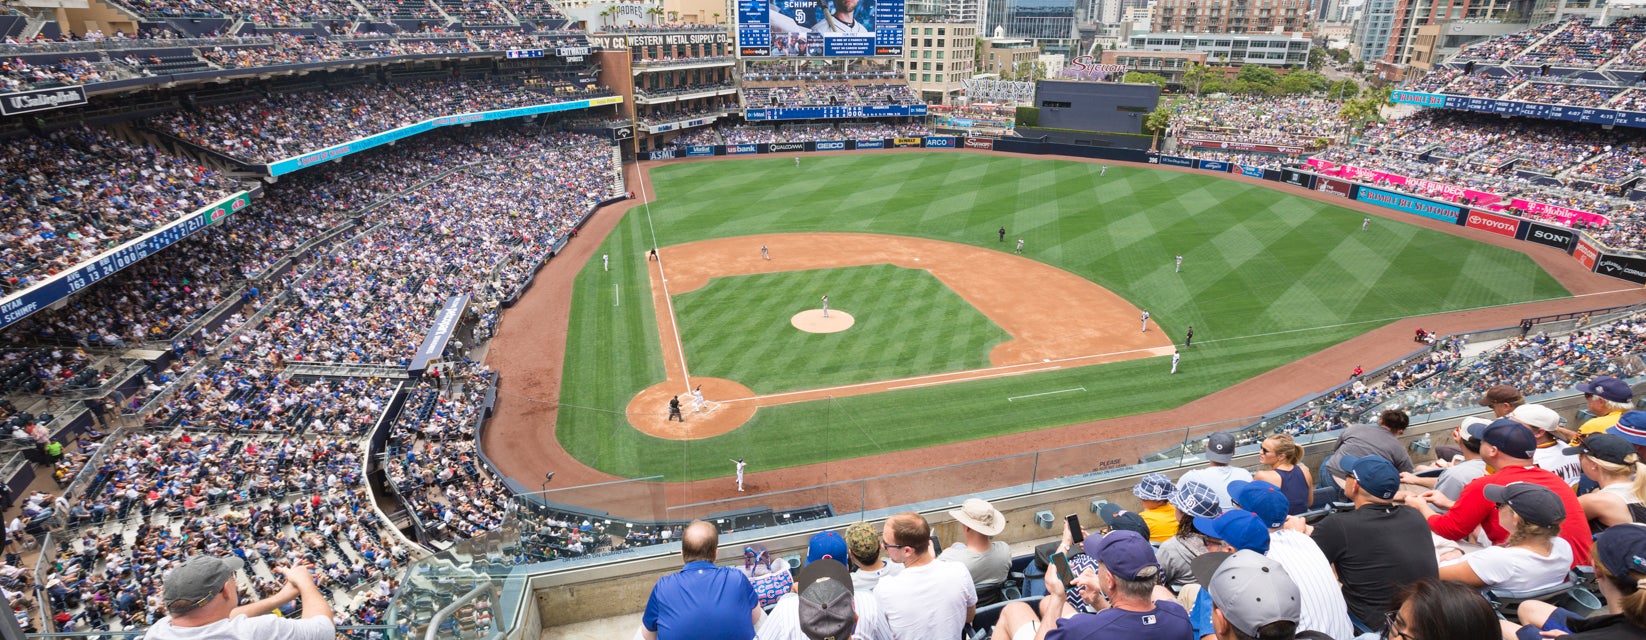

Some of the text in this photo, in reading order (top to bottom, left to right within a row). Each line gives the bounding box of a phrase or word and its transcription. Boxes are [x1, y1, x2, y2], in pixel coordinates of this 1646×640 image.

[616, 5, 642, 18] PADRES
[628, 34, 728, 46] WESTERN METAL SUPPLY CO.
[1072, 56, 1128, 76] Sycuan
[770, 143, 802, 152] QUALCOMM
[1427, 182, 1444, 193] RUN
[1444, 185, 1465, 197] DECK
[1368, 192, 1459, 219] BUMBLE BEE SEAFOODS
[188, 214, 205, 230] 2:17
[1482, 218, 1515, 231] TOYOTA
[1534, 230, 1570, 244] SONY
[66, 271, 80, 282] AVG
[67, 264, 114, 294] .163 13 24
[1624, 268, 1646, 278] CORNE
[1, 298, 22, 314] RYAN
[4, 302, 37, 323] SCHIMPF
[552, 462, 580, 480] WYNN
